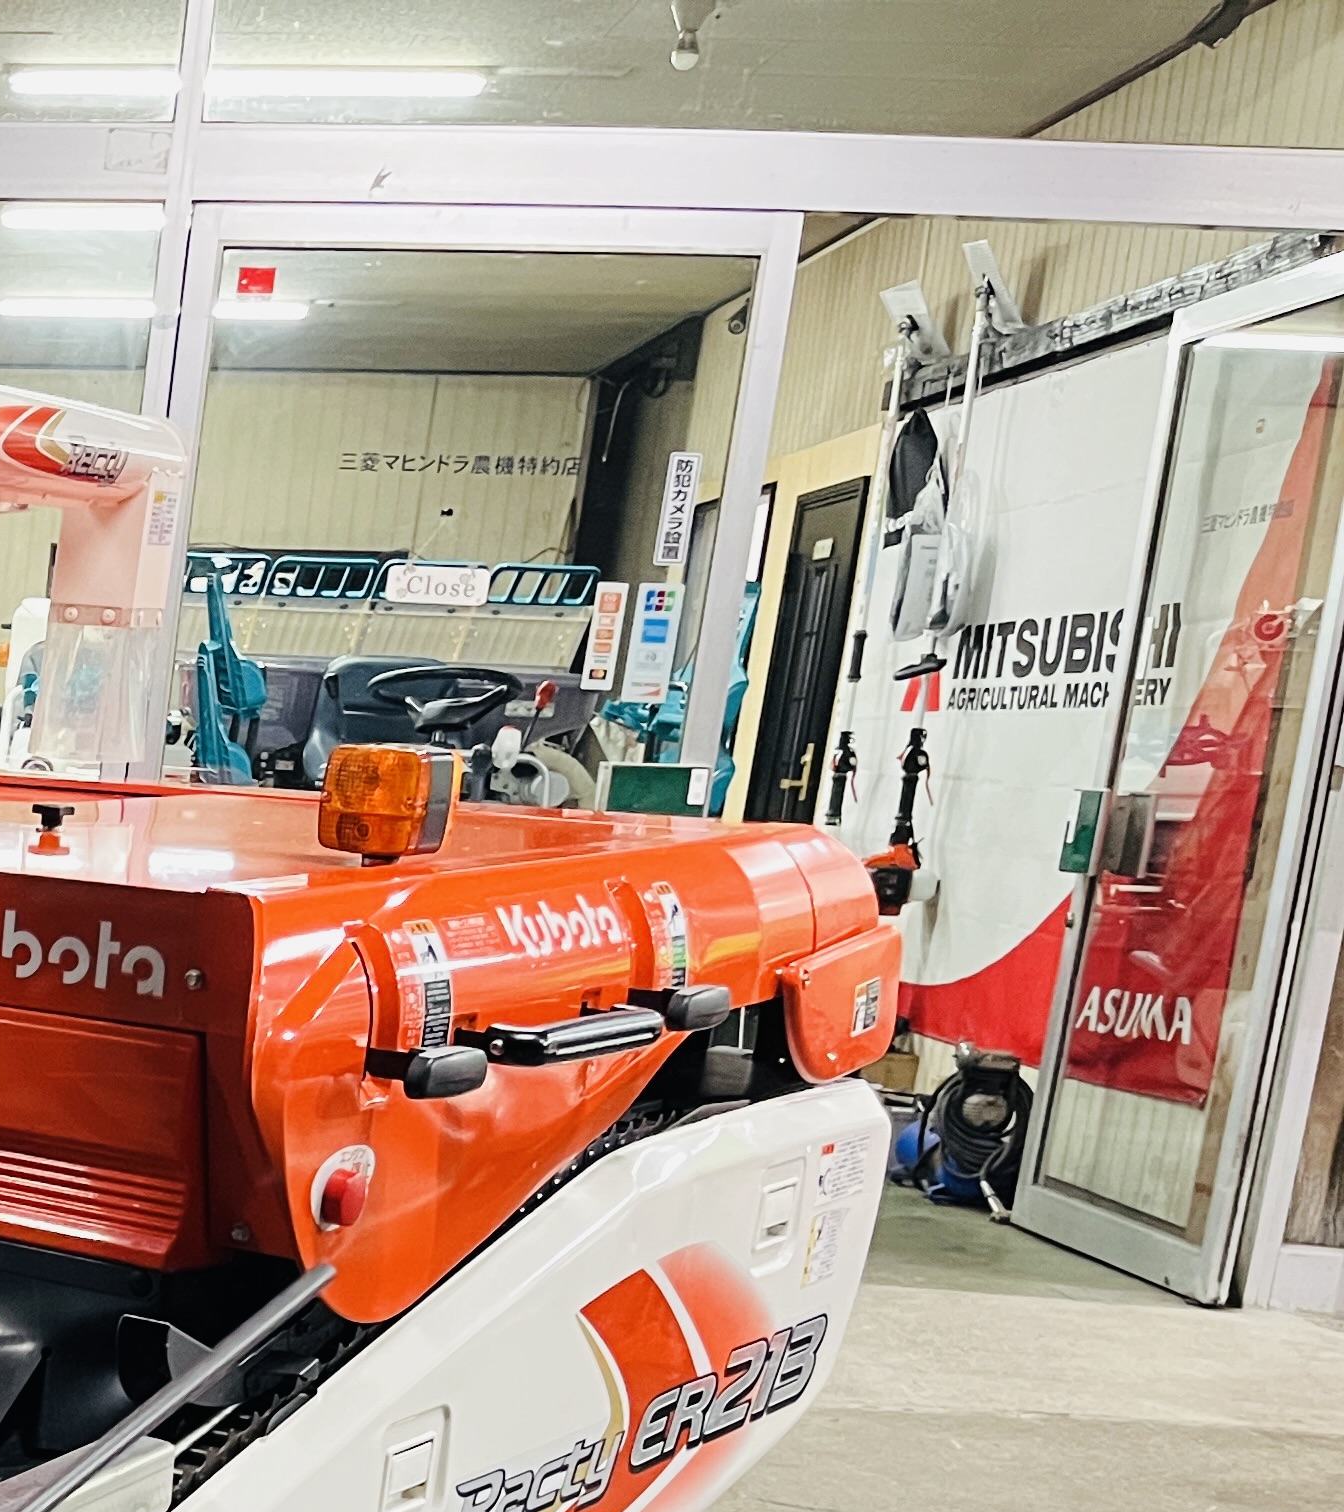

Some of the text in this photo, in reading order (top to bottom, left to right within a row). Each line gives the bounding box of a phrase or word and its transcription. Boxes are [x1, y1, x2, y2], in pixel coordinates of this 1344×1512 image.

[339, 453, 582, 476] 三菱マヒンドラ農機特約店
[662, 459, 694, 559] 防犯カメラ設置
[406, 575, 476, 598] Close
[946, 677, 1172, 711] AGRICULTURAL MACHERY
[498, 893, 623, 957] Kubota
[1075, 985, 1192, 1045] ASUMA
[628, 1313, 829, 1474] ER213
